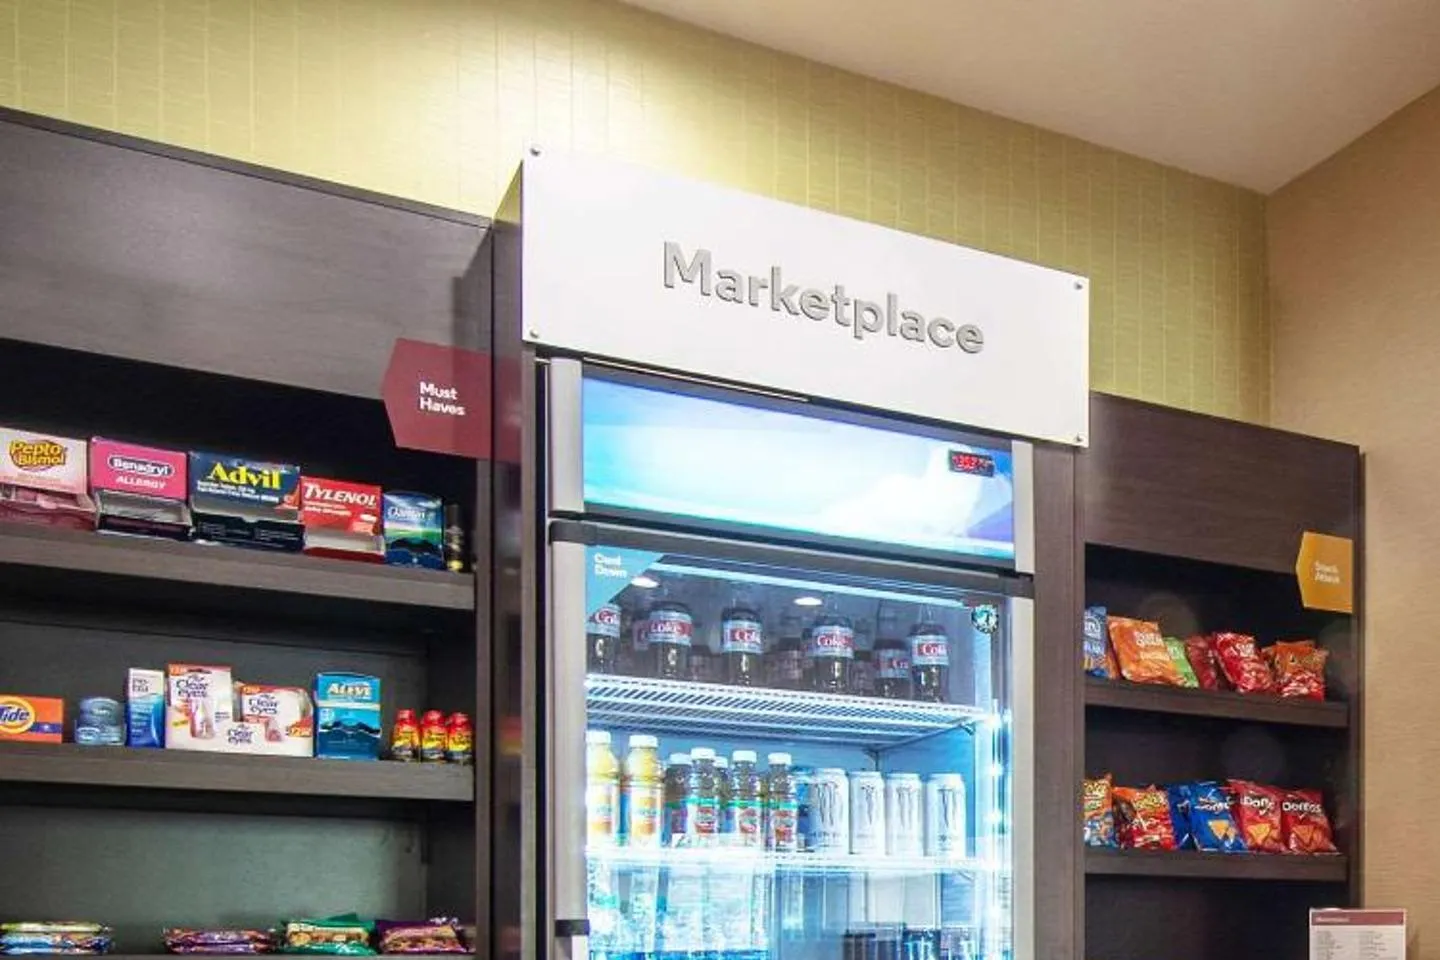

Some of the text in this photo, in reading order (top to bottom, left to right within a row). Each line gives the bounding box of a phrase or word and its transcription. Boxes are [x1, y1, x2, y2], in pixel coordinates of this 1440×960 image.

[663, 241, 985, 354] Marketplace
[420, 381, 458, 400] Must
[420, 396, 466, 416] Haves
[10, 440, 62, 455] Pepto
[18, 452, 66, 466] Bismol
[113, 456, 169, 476] Benadryl
[116, 475, 166, 490] ALLERGY
[206, 461, 281, 490] Advil
[303, 482, 377, 508] TYLENOL
[176, 679, 209, 691] Clear
[1282, 801, 1323, 813] Doritos
